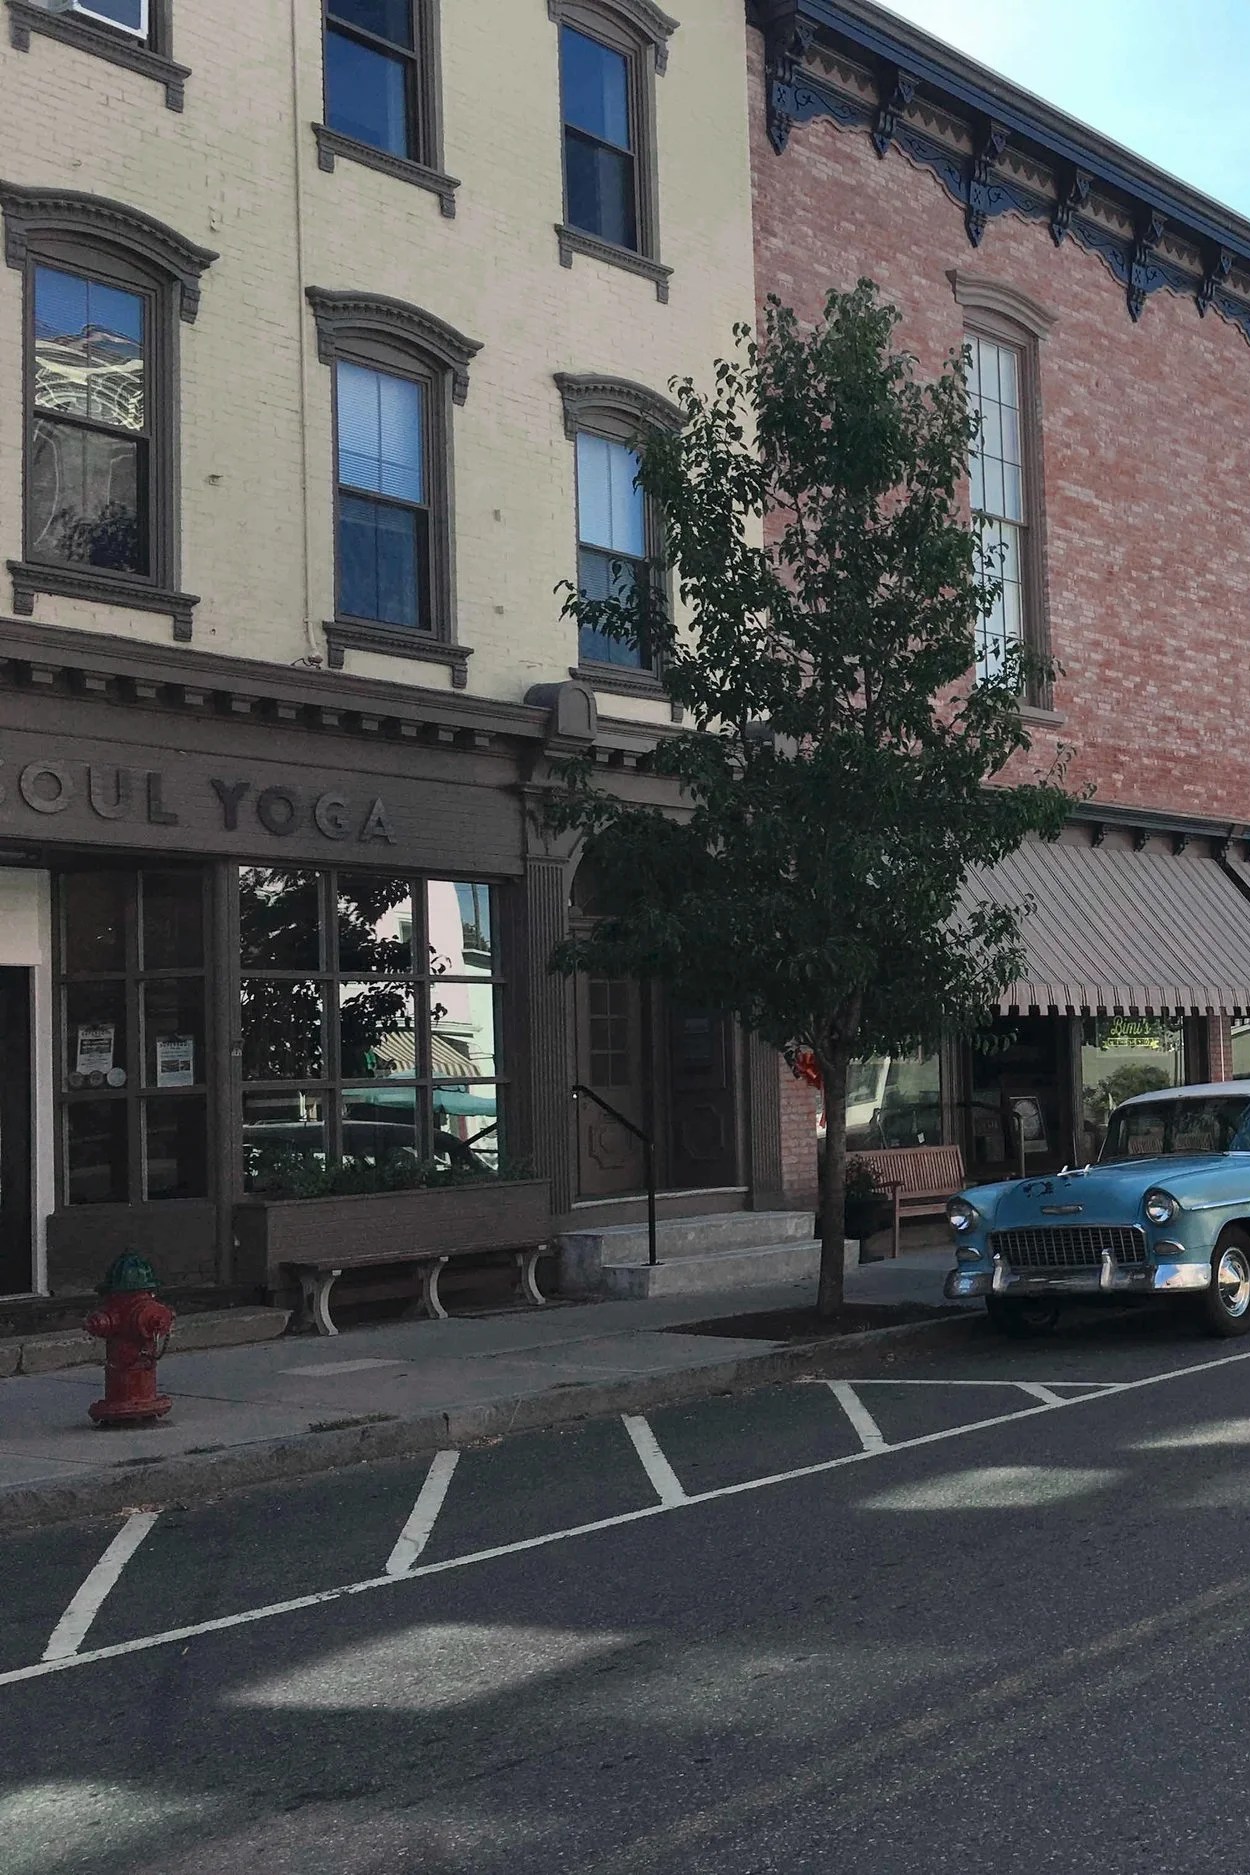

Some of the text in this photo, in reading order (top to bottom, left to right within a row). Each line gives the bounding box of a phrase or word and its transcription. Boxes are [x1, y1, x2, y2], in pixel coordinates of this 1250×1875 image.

[0, 758, 398, 846] OUL YOGA
[1110, 1015, 1152, 1036] Bimi's
